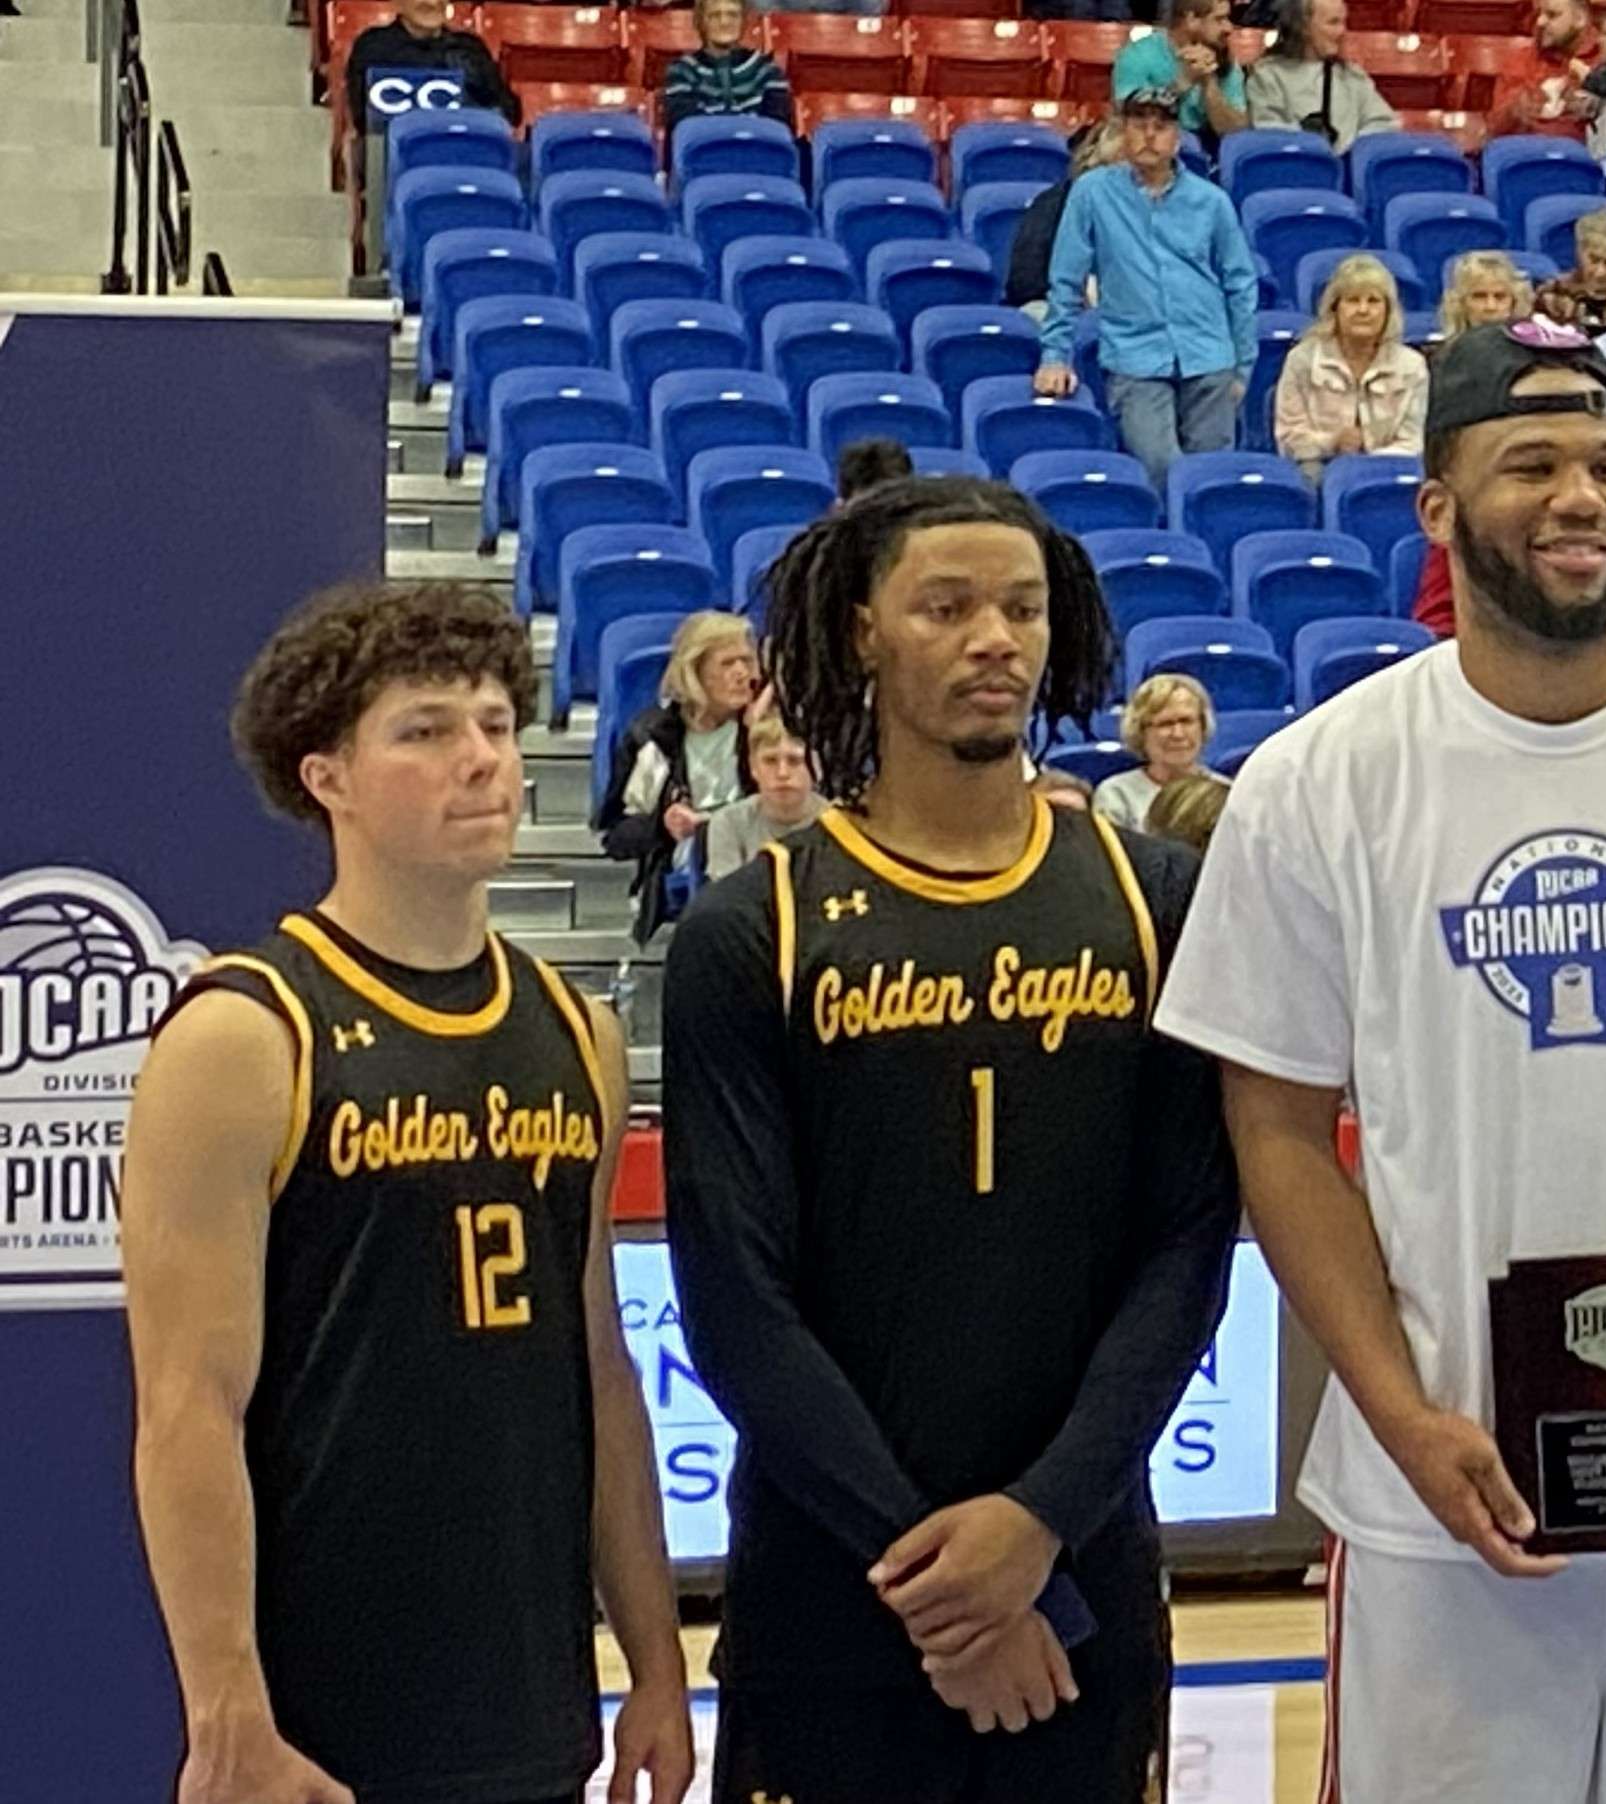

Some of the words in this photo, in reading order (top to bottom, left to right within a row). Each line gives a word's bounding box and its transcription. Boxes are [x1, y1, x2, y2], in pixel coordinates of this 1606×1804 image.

[369, 77, 461, 114] CC
[814, 959, 975, 1045] Golden
[989, 945, 1136, 1053] Eagles
[329, 1094, 478, 1178] Golden
[486, 1084, 599, 1191] Eagles
[971, 1066, 994, 1194] 1
[38, 1233, 97, 1248] ARENA
[456, 1203, 532, 1329] 12
[664, 1443, 720, 1503] S
[1173, 1419, 1217, 1473] S
